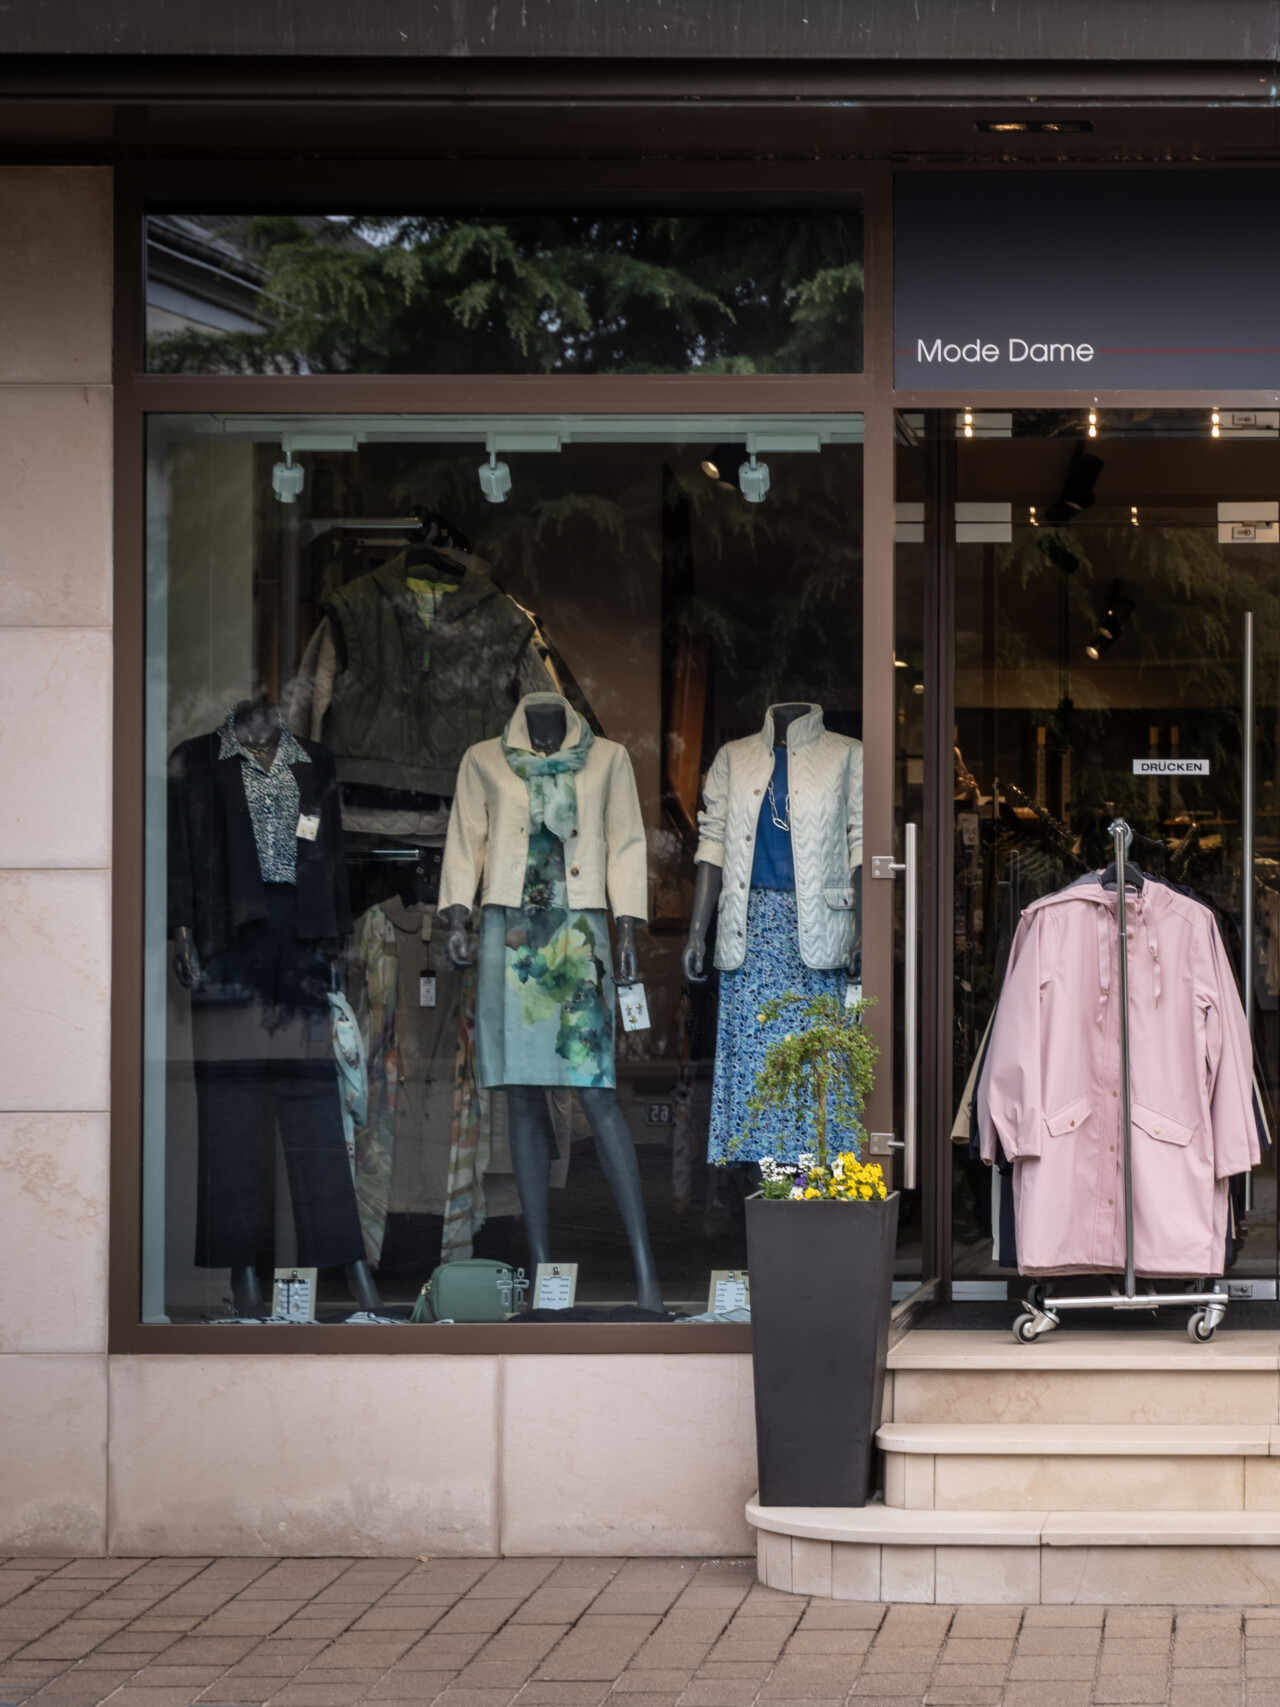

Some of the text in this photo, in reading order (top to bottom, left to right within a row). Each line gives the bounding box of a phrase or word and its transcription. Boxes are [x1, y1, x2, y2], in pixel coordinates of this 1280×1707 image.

[917, 338, 1095, 363] Mode Dame
[1141, 761, 1203, 772] DRÜCKEN
